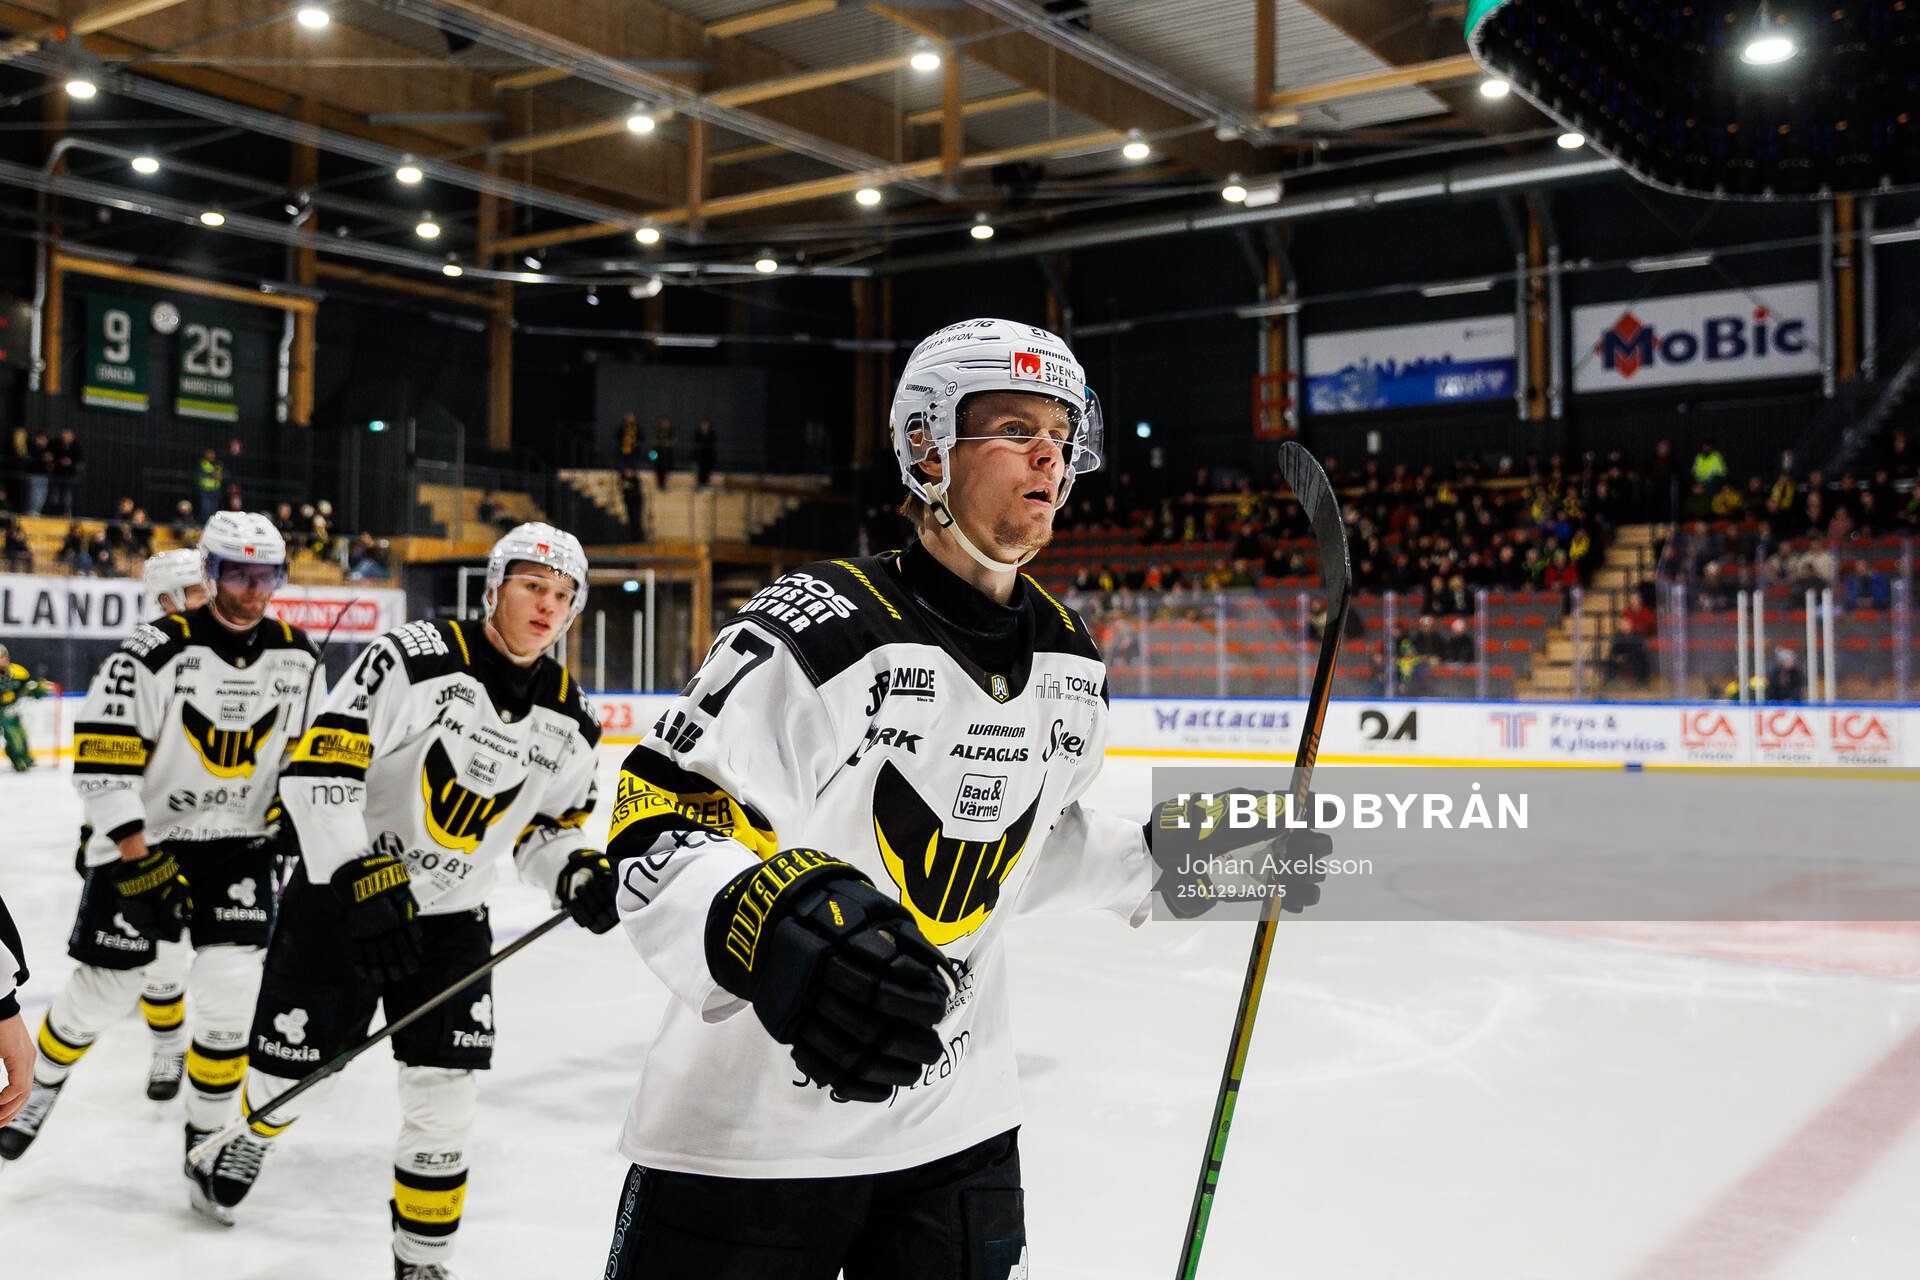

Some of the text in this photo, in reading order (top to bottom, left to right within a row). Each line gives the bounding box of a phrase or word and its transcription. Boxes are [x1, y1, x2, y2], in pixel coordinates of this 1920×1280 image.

[104, 310, 131, 364] 9
[1601, 305, 1804, 371] MoBic
[183, 324, 233, 379] 26
[1027, 347, 1072, 364] WARRIOR
[1045, 372, 1071, 389] SPEL
[891, 667, 935, 690] MIDE
[1065, 676, 1099, 697] TOTAL
[653, 709, 704, 753] ABB
[967, 723, 1026, 738] WARRIOR
[1681, 710, 1735, 738] ICA
[1756, 710, 1813, 739] ICA
[1830, 713, 1889, 741] ICA
[949, 744, 1029, 762] ALFAGLAS
[959, 801, 998, 818] Värme
[214, 906, 268, 921] Telexia
[258, 1035, 320, 1061] Telexia
